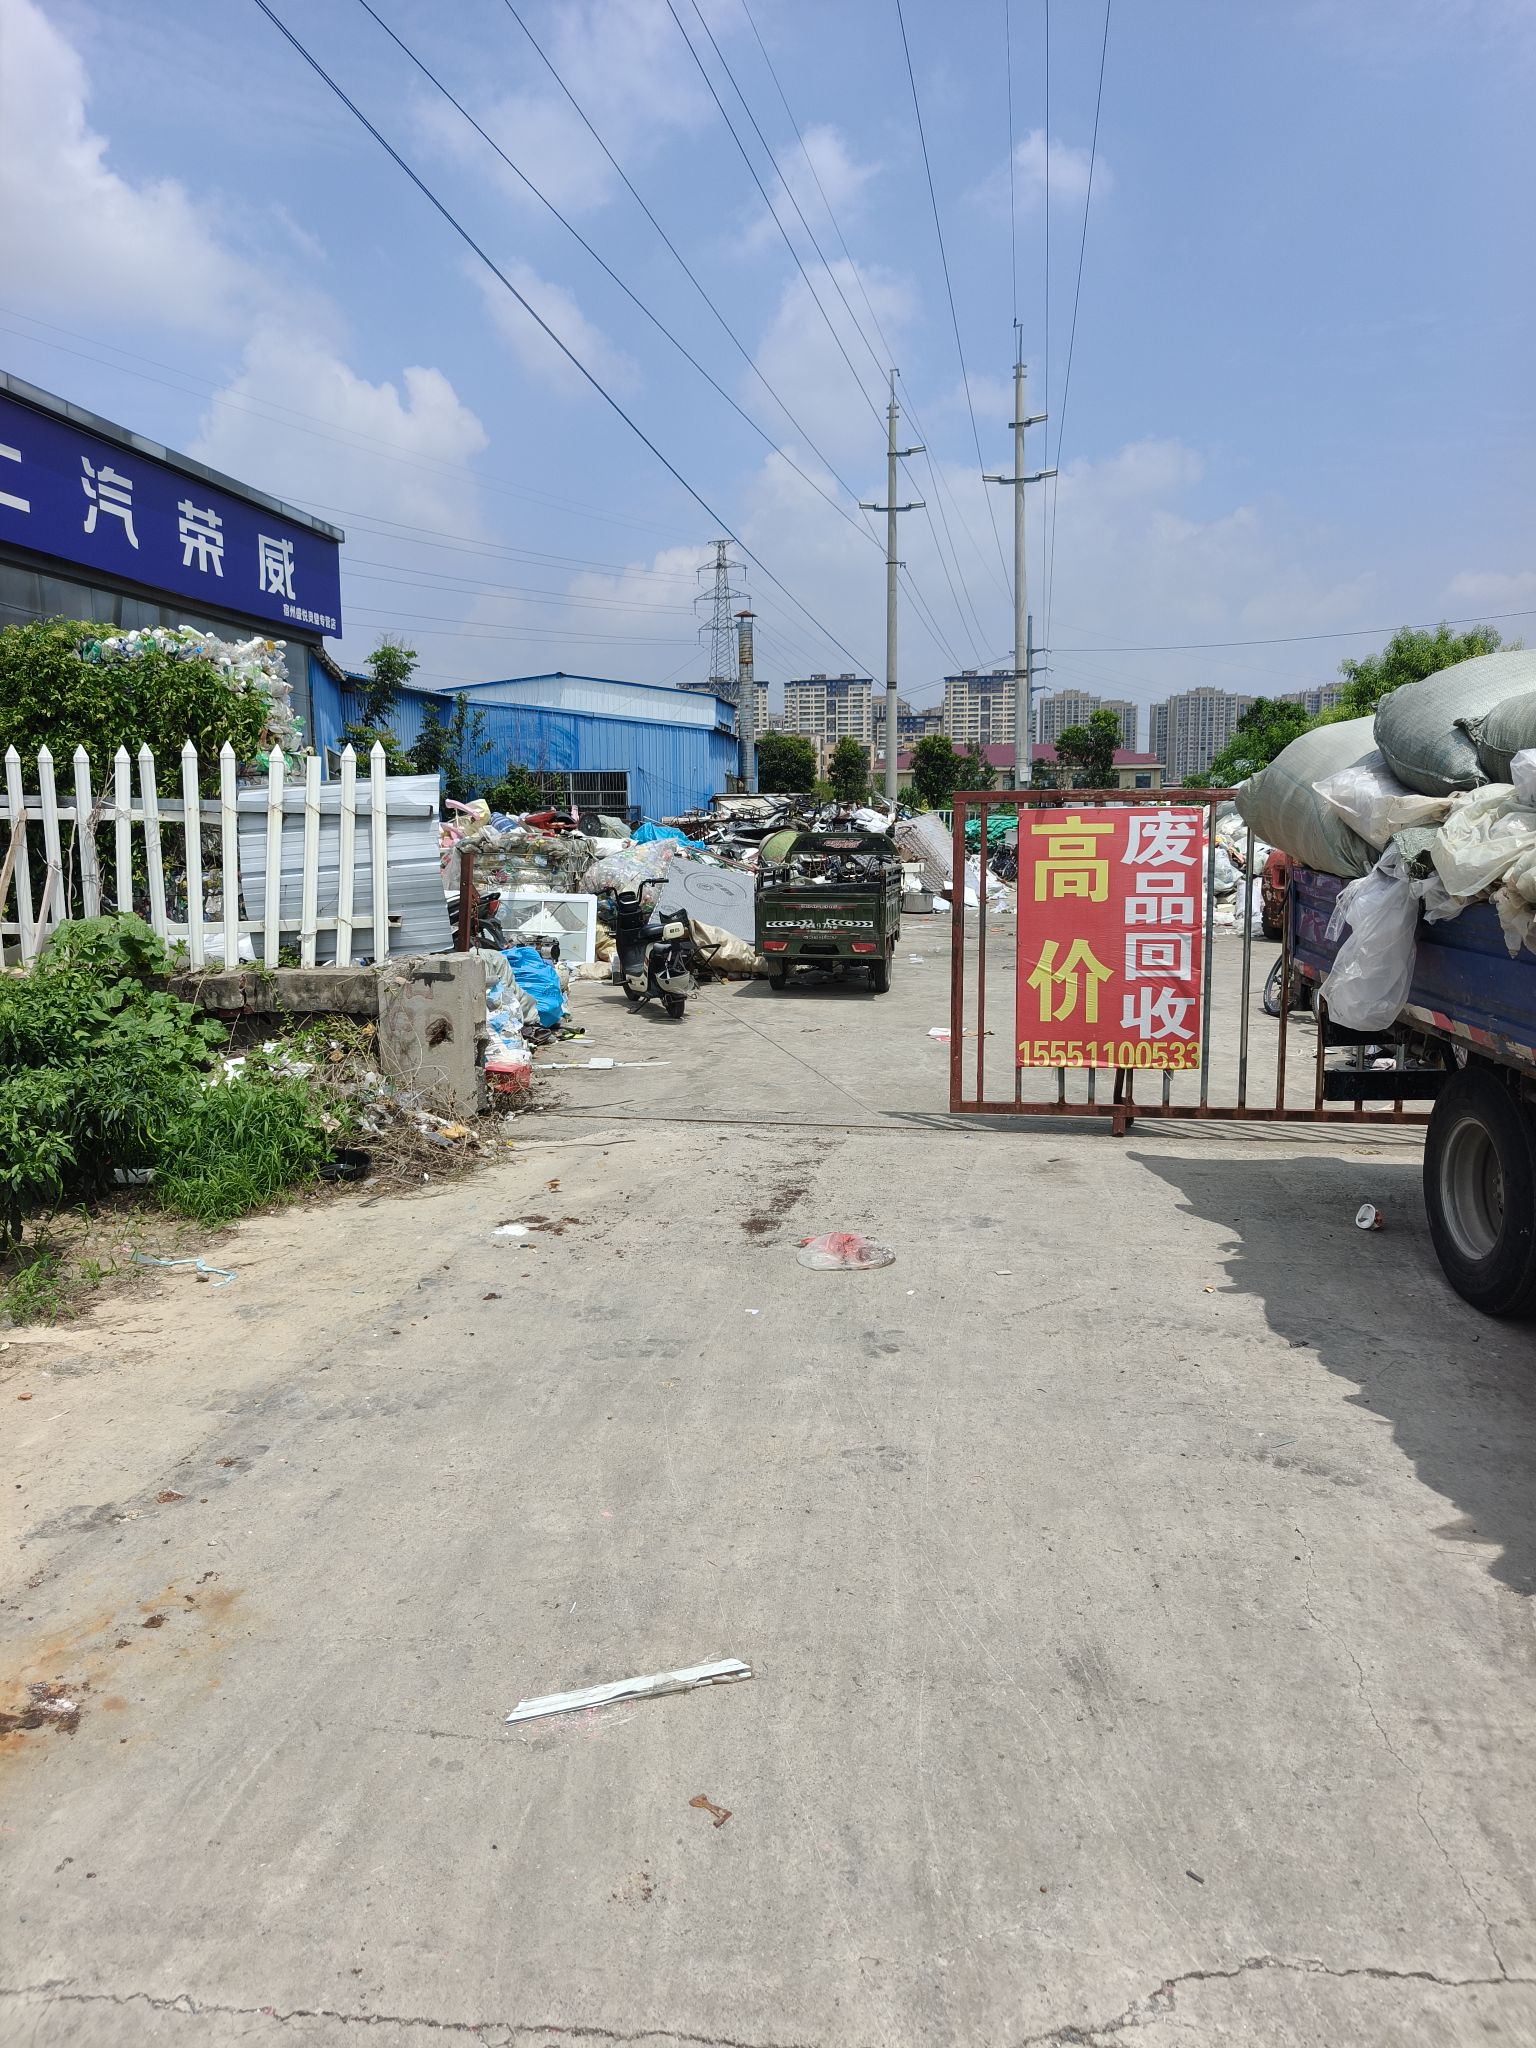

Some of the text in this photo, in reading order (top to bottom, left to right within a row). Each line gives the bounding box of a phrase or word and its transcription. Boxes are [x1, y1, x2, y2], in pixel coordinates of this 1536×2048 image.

[1027, 815, 1115, 1024] 高价
[1120, 811, 1199, 1040] 废品回收
[1019, 1040, 1200, 1069] 15551100533
